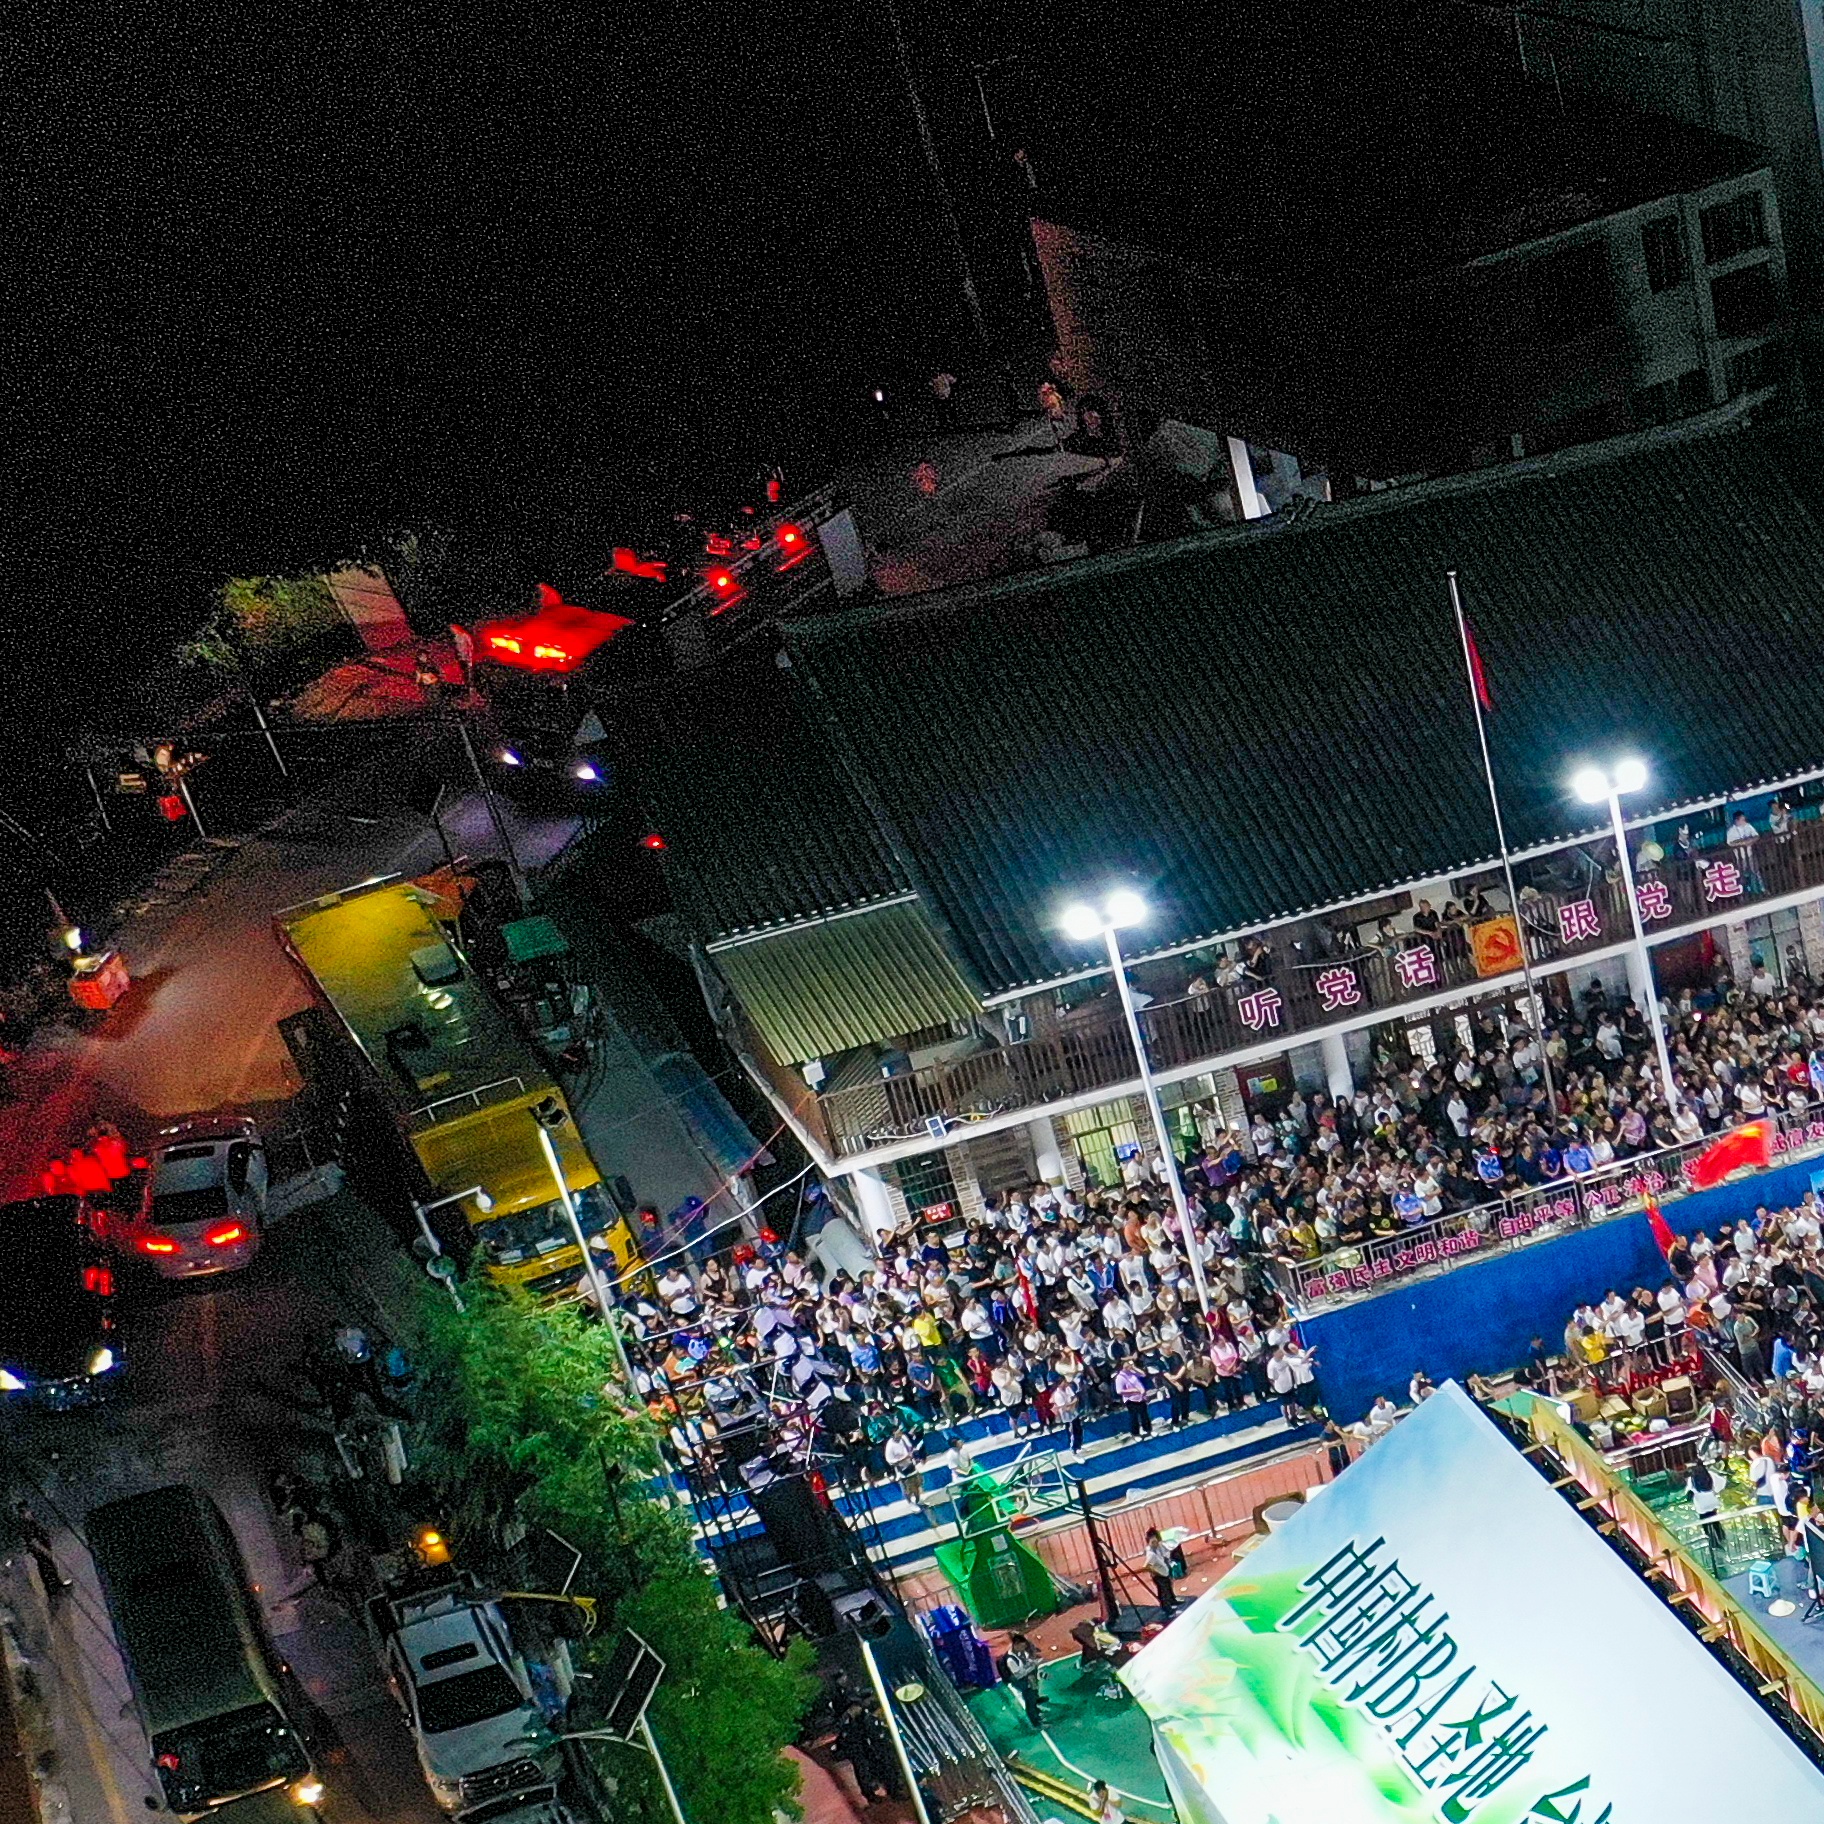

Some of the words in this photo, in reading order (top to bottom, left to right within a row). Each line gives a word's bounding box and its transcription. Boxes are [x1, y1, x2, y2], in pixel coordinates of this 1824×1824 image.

[1238, 945, 1436, 1030] 听党话
[1558, 861, 1743, 944] 跟党走
